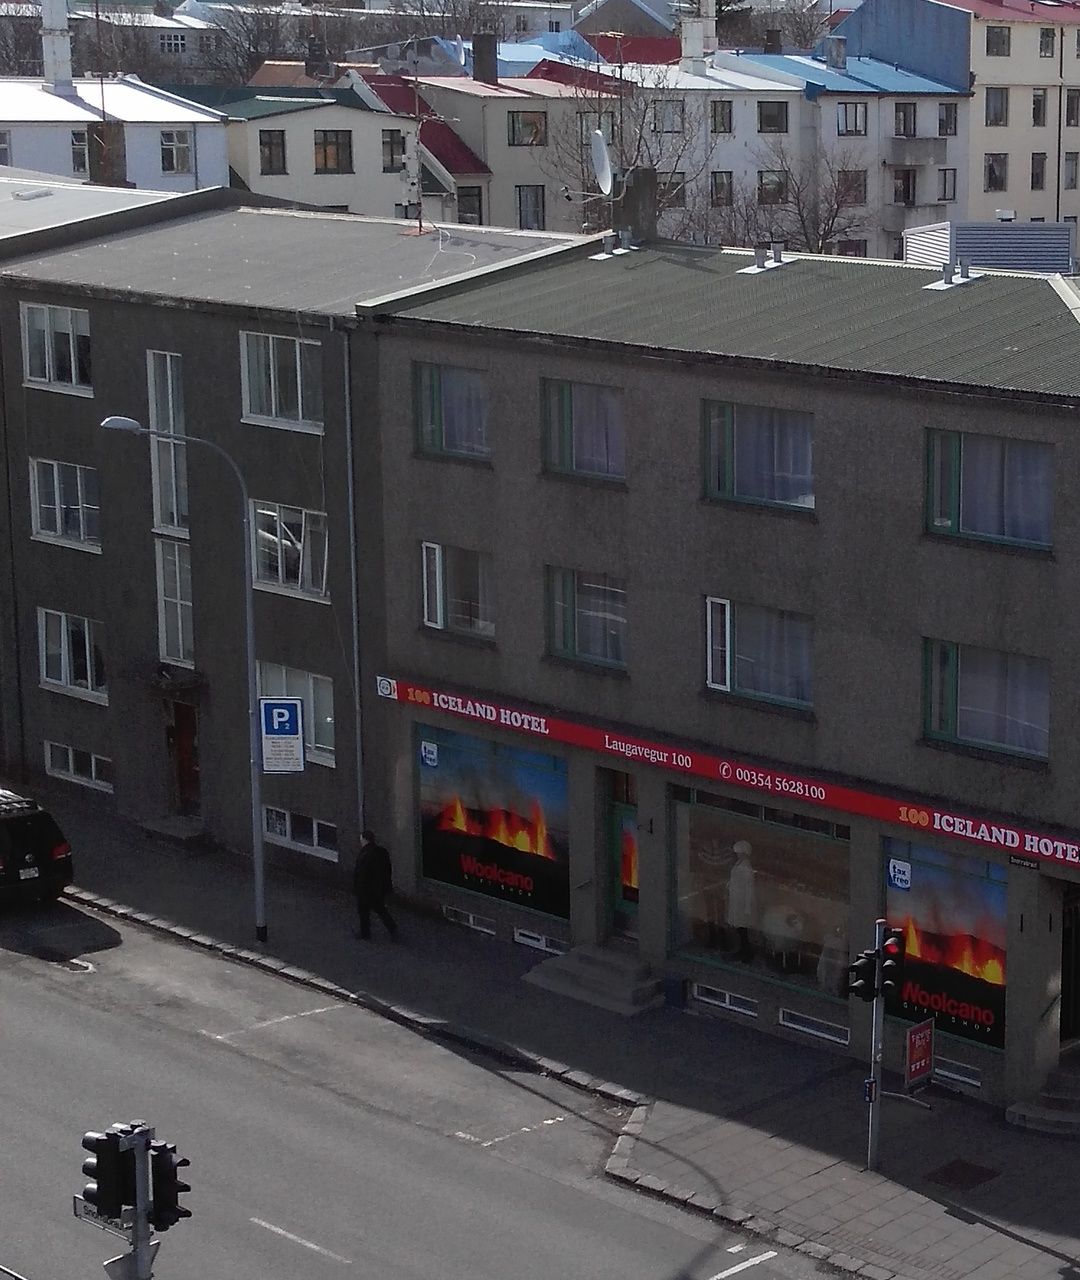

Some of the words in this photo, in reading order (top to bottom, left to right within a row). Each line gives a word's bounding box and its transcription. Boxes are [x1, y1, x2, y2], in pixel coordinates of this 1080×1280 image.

[272, 707, 290, 730] P
[406, 687, 430, 705] 100
[432, 692, 498, 721] ICELAND
[499, 708, 550, 735] HOTEL
[604, 735, 669, 763] Laugavegur
[671, 752, 692, 769] 100
[735, 766, 772, 790] 00354
[773, 776, 826, 800] 5628100
[898, 806, 929, 827] 100
[932, 812, 1020, 848] ICELAND
[458, 852, 535, 893] Woolcano
[893, 864, 906, 876] tax
[901, 980, 996, 1026] Woolcano
